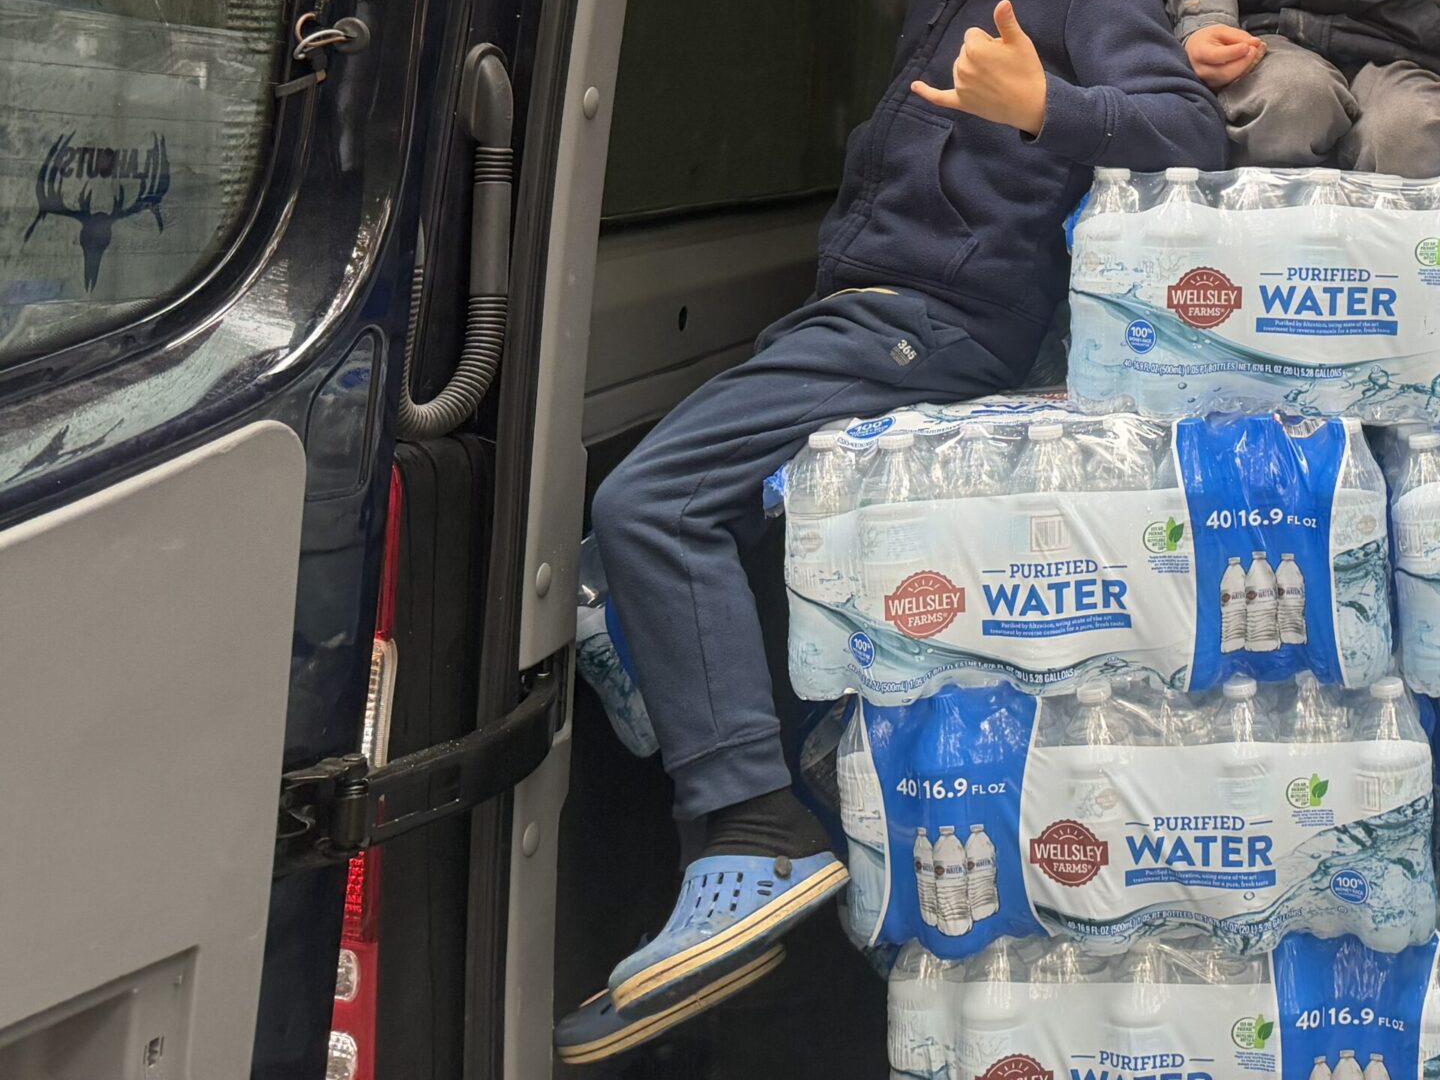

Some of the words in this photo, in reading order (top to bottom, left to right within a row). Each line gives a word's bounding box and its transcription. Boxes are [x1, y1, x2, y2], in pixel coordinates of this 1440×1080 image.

[1287, 267, 1371, 282] PURIFIED
[1171, 290, 1238, 305] WELLSLEY
[1259, 285, 1397, 316] WATER
[897, 339, 917, 360] 365
[1238, 363, 1250, 371] NET
[1315, 367, 1342, 378] GALLONS
[1206, 510, 1232, 529] 40
[1238, 508, 1283, 526] 16.9
[1287, 515, 1301, 525] FL
[1303, 518, 1317, 528] OZ
[1009, 559, 1098, 579] PURIFIED
[888, 592, 960, 616] WELLSLEY
[982, 578, 1128, 617] WATER
[896, 778, 917, 797] 40
[922, 777, 967, 799] 16.9
[971, 784, 986, 795] FL
[987, 783, 1006, 793] OZ
[1153, 815, 1245, 831] PURIFIED
[1034, 843, 1103, 862] WELLSLEY
[1125, 834, 1273, 867] WATER
[1336, 876, 1364, 888] 100%
[1295, 1010, 1320, 1030] 40
[1328, 1007, 1374, 1025] 16.9
[1378, 1017, 1390, 1027] FL
[1392, 1020, 1405, 1031] OZ
[1099, 1051, 1185, 1071] PURIFIED
